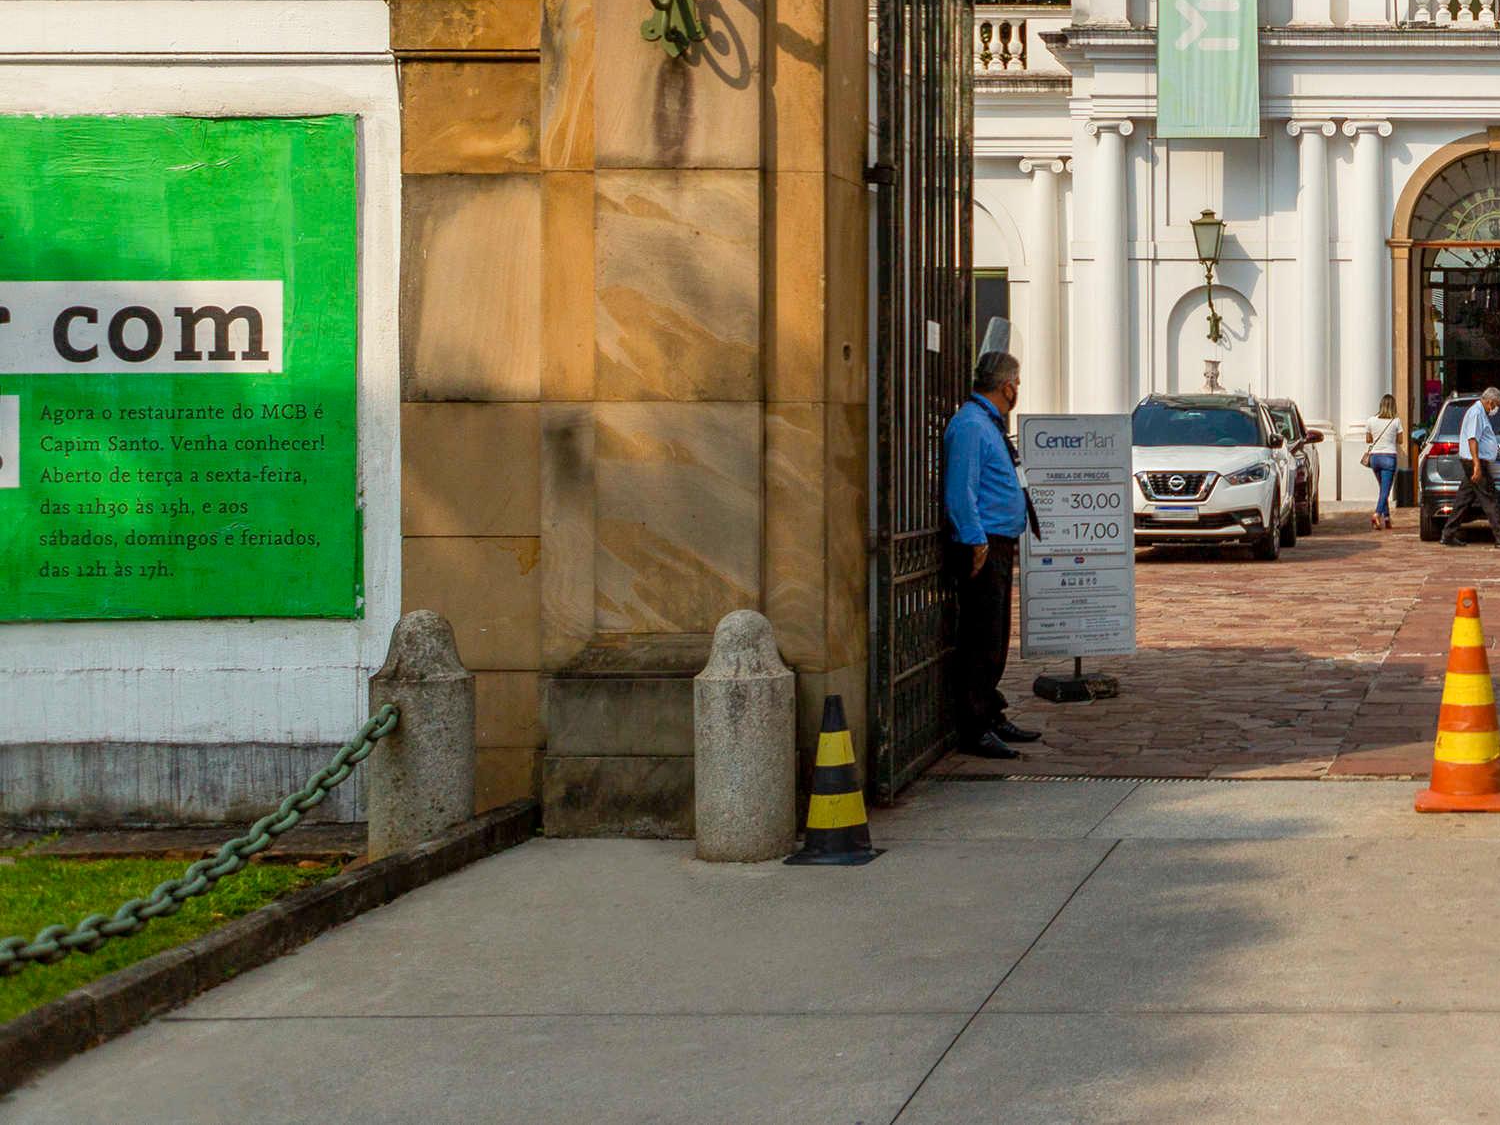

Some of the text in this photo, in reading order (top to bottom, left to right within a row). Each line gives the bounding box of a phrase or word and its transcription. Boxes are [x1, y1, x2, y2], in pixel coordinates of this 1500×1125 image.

[53, 305, 269, 363] com
[40, 403, 324, 425] Agora o restaurante do MCB é
[40, 434, 325, 457] Capim Santo. Venha conhecer!
[40, 466, 308, 486] Aberto de terça a sexta-feira,
[39, 497, 249, 518] das 11h30 às 15h, e aos
[1071, 493, 1121, 510] 30,00
[39, 528, 321, 550] sábados, domingos e feriados,
[1073, 522, 1120, 541] 17,00
[39, 560, 174, 580] das 12h às 17h.
